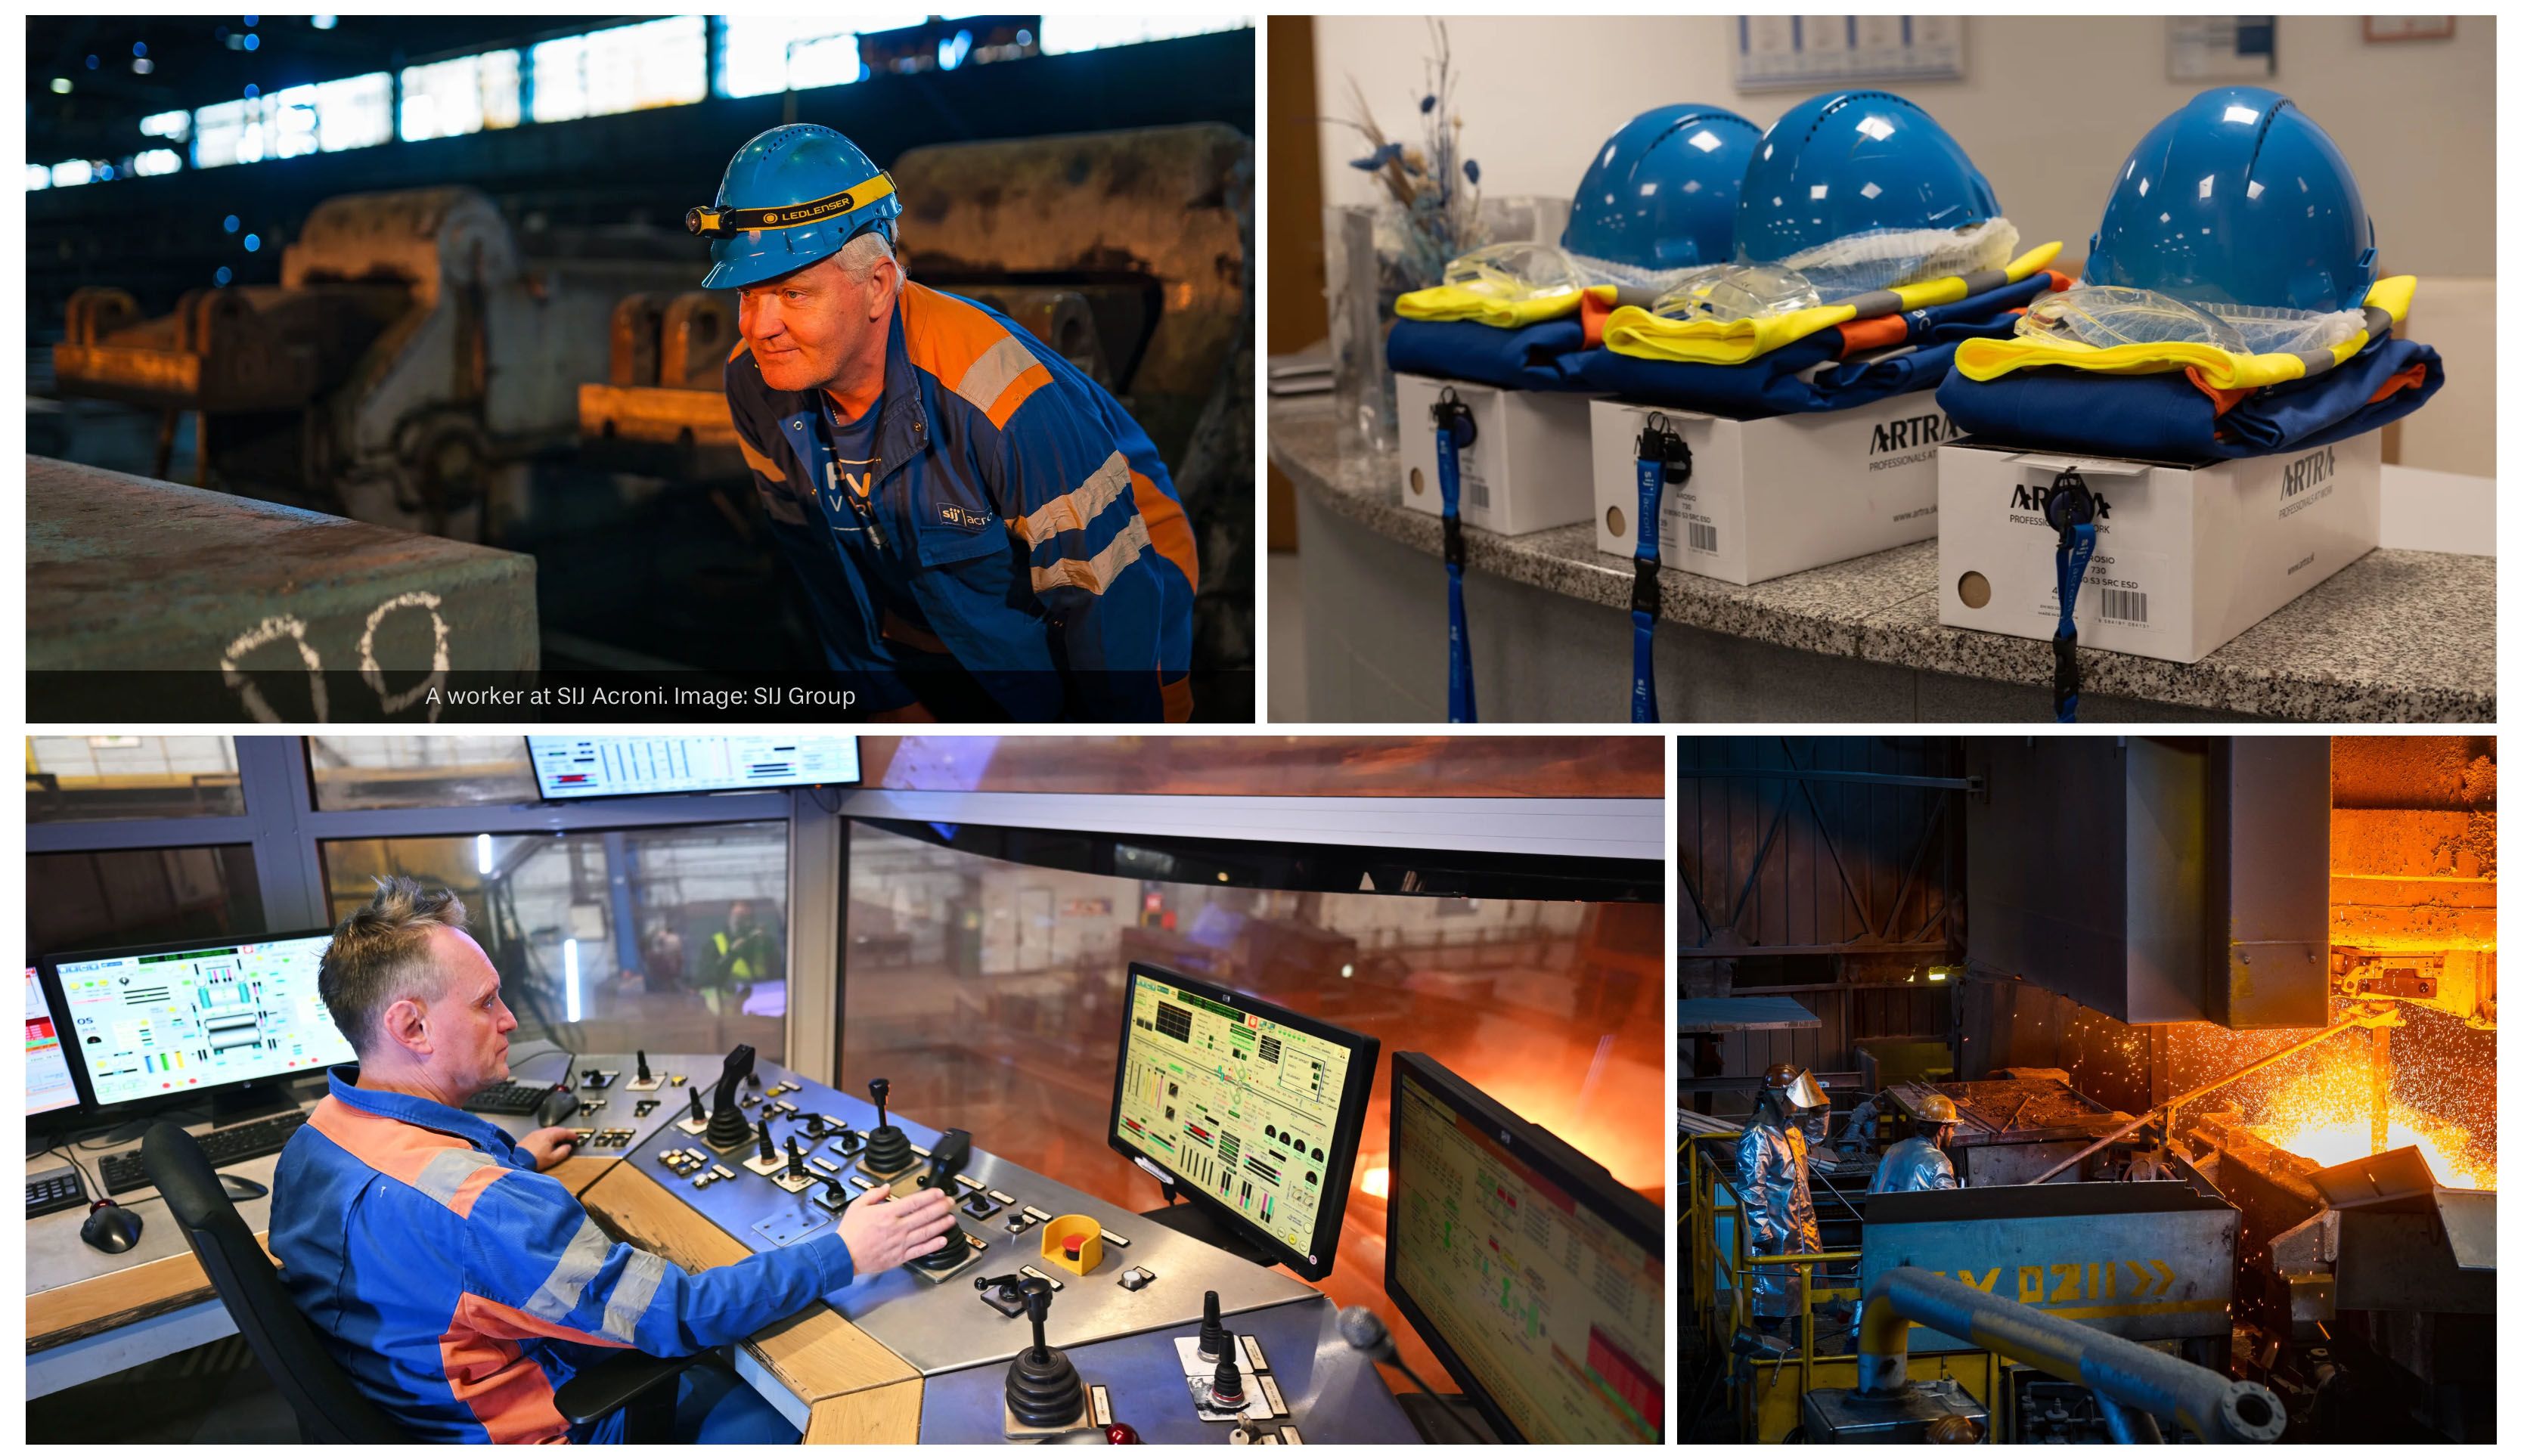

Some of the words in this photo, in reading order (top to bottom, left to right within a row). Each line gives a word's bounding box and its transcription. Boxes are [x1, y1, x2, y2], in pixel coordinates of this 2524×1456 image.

[782, 197, 850, 221] LEDLENSER
[1870, 414, 1959, 456] ARTRA
[1869, 451, 1927, 472] PROFESSIONALS
[1927, 449, 1938, 460] AT
[2281, 446, 2336, 502] ARTRA
[2010, 483, 2112, 519] ARA
[942, 507, 960, 522] sij
[966, 512, 992, 525] acro
[2009, 514, 2051, 527] PROFESSIO
[2093, 525, 2110, 534] ORK
[2089, 555, 2116, 565] ROSIO
[2091, 566, 2107, 575] 730
[2102, 578, 2119, 587] SRC
[2121, 581, 2139, 590] ESD
